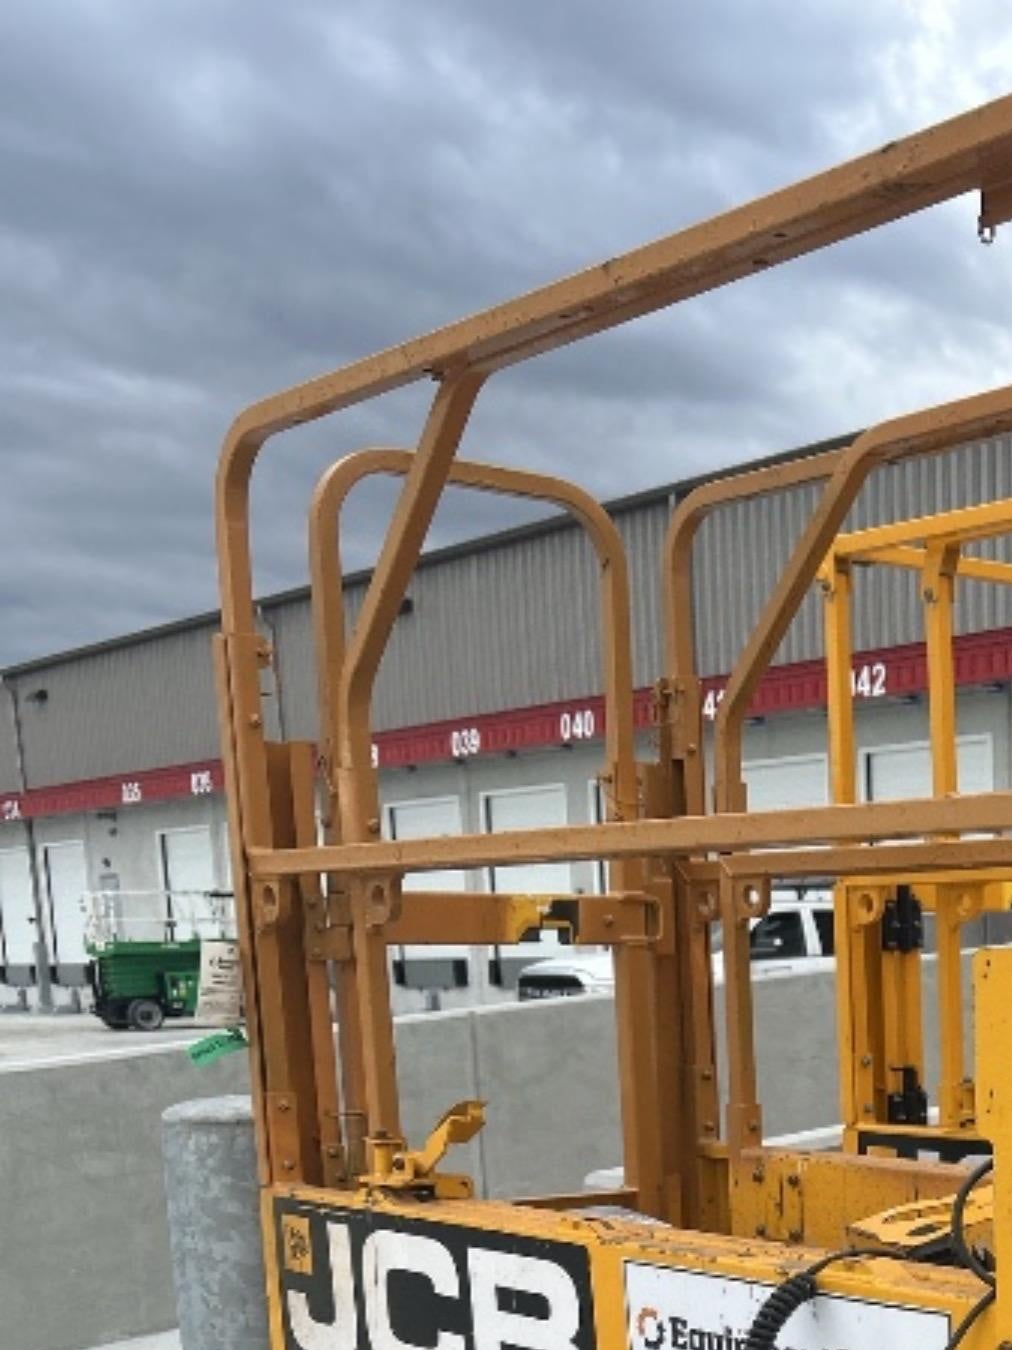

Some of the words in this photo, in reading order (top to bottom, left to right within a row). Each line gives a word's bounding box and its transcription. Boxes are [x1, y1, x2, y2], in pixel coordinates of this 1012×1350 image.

[850, 661, 887, 698] 42
[559, 709, 596, 741] 040
[450, 727, 481, 758] 039
